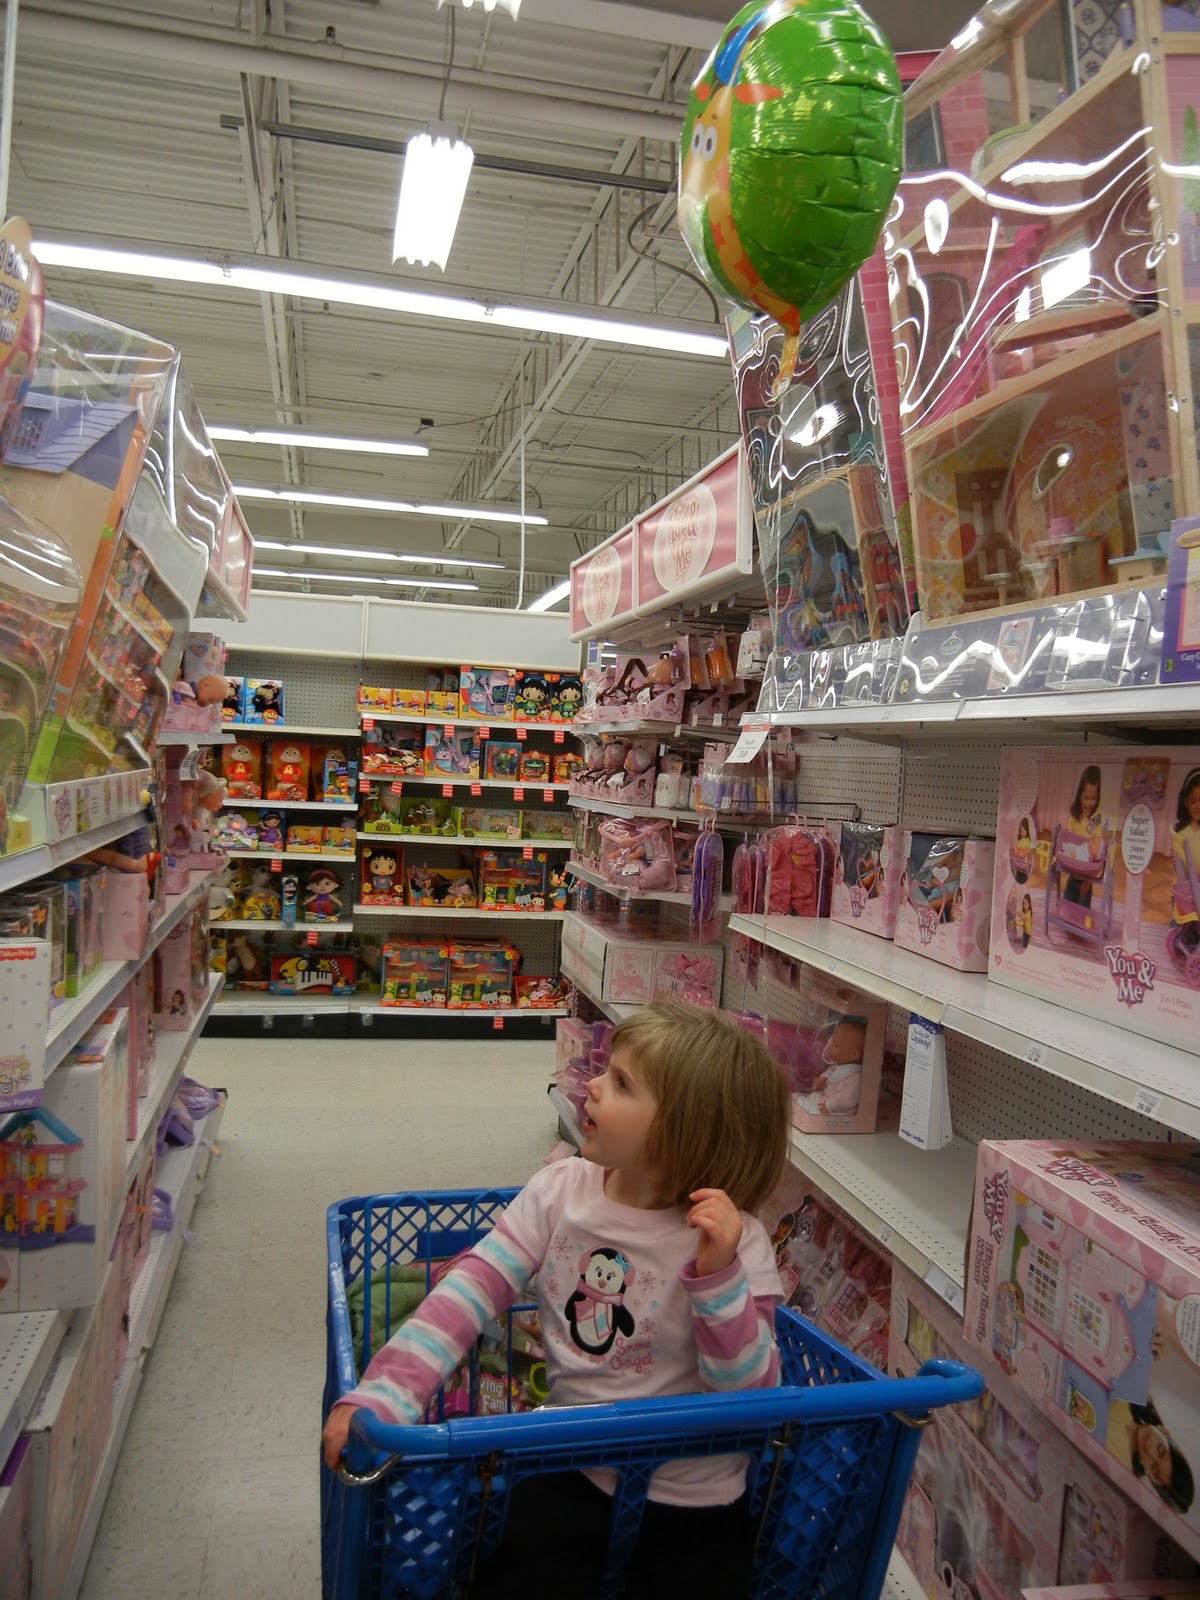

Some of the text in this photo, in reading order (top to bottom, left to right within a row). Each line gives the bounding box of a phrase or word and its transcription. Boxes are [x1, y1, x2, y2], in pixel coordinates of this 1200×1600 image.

[1129, 827, 1149, 837] Value!
[1130, 815, 1149, 829] Super
[919, 928, 932, 944] Me
[1105, 946, 1137, 976] You
[1136, 957, 1156, 991] &
[1117, 977, 1145, 1004] Me
[984, 1177, 997, 1218] Me
[996, 1170, 1009, 1213] You
[615, 1337, 651, 1355] Snow
[483, 1394, 518, 1414] Famiy
